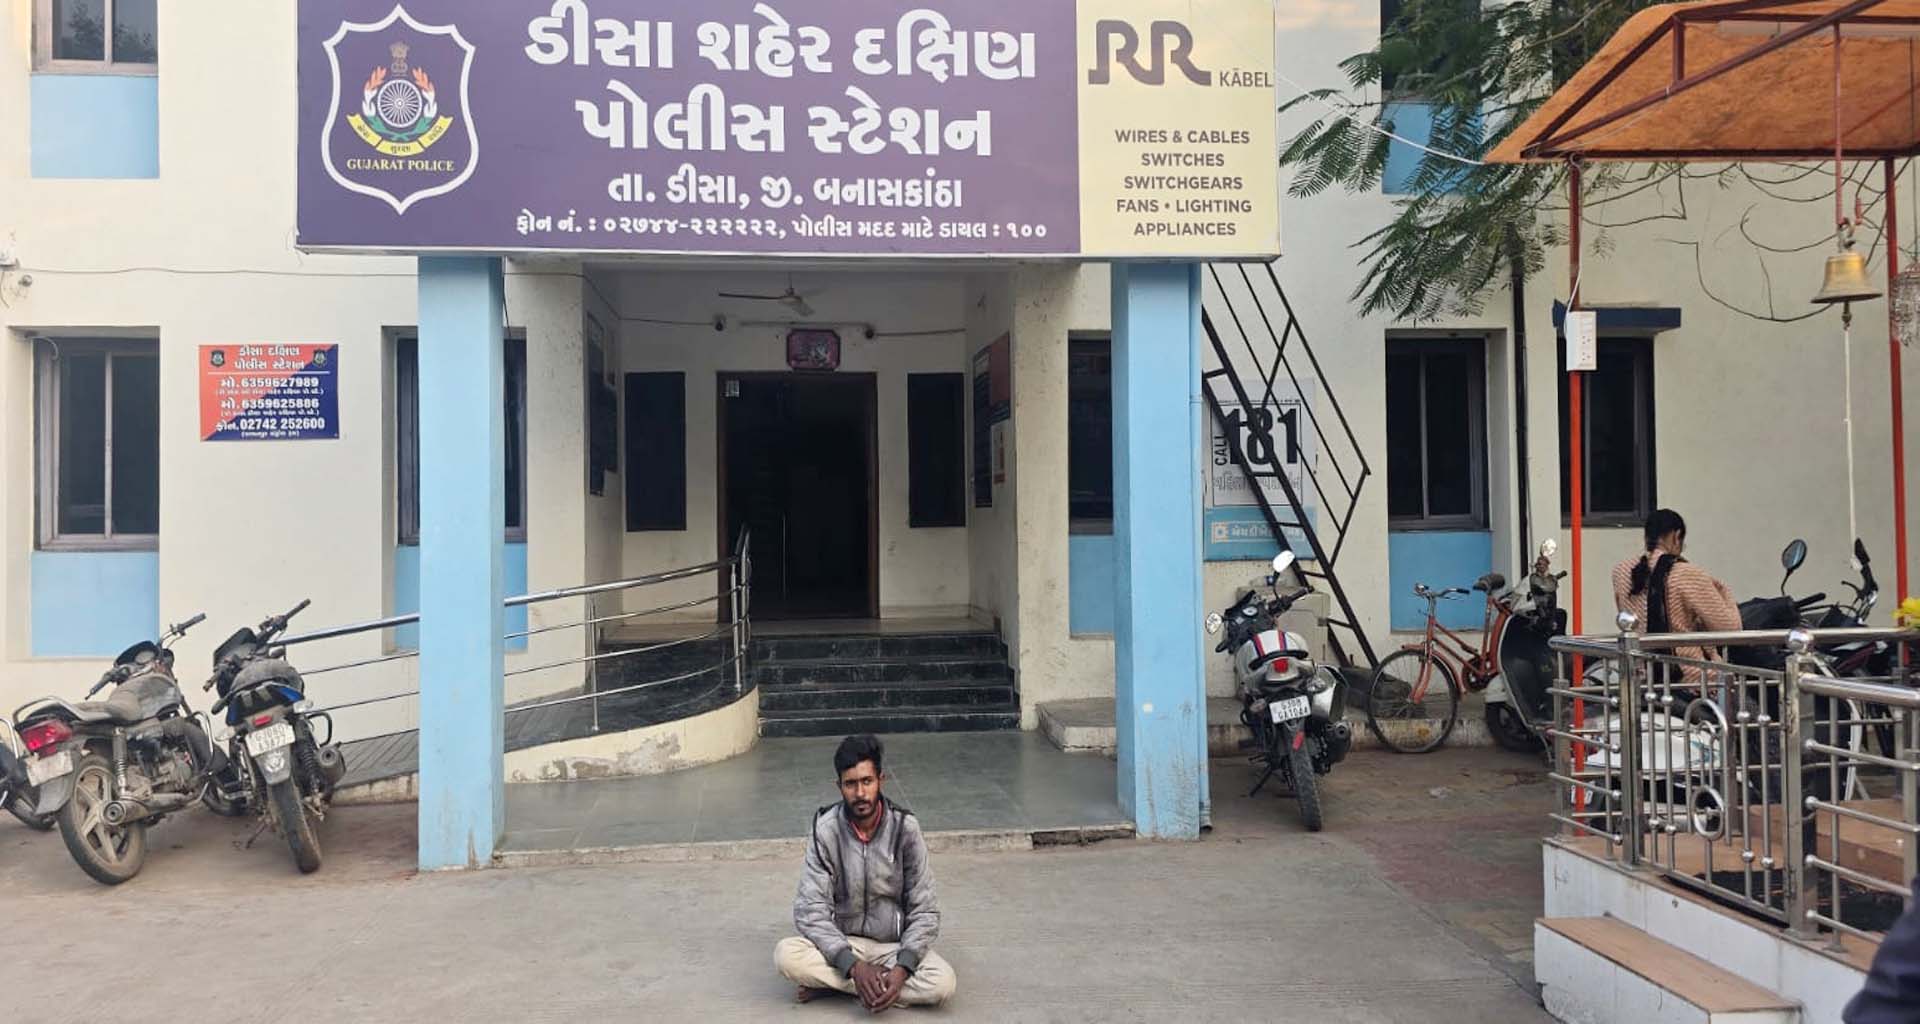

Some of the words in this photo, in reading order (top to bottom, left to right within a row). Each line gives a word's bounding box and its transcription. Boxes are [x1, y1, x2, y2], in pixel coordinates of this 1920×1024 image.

[524, 0, 674, 69] ડીસા
[696, 2, 833, 78] શહેર
[852, 8, 1036, 83] દક્ષિણ
[1088, 19, 1212, 87] RR
[575, 79, 786, 152] પોલીસ
[807, 85, 992, 156] સ્ટેશન
[1115, 129, 1168, 144] WIRES
[1172, 130, 1183, 144] &
[1187, 130, 1251, 145] CABLES
[346, 158, 404, 171] GUJARAT
[407, 159, 455, 172] POLICE
[1141, 153, 1226, 168] SWITCHES
[608, 173, 657, 203] તા.
[666, 162, 751, 210] ડીસા,
[760, 175, 803, 209] જી.
[813, 167, 964, 208] બનાસકાંઠા
[1124, 175, 1244, 190] SWITCHGEARS
[1116, 199, 1160, 214] FANS
[1176, 199, 1253, 214] LIGHTING
[516, 209, 551, 236] ફોન
[792, 213, 852, 238] પોલીસ
[858, 220, 897, 238] મદદ
[902, 215, 934, 239] માટે
[939, 221, 987, 239] ડાયલ
[1006, 222, 1048, 239] ૧૦૦
[1133, 222, 1238, 236] APPLIANCES
[235, 358, 267, 369] પોલીસ
[272, 358, 304, 369] સ્ટેશન
[280, 417, 325, 430] 252600
[1224, 407, 1298, 466] 181
